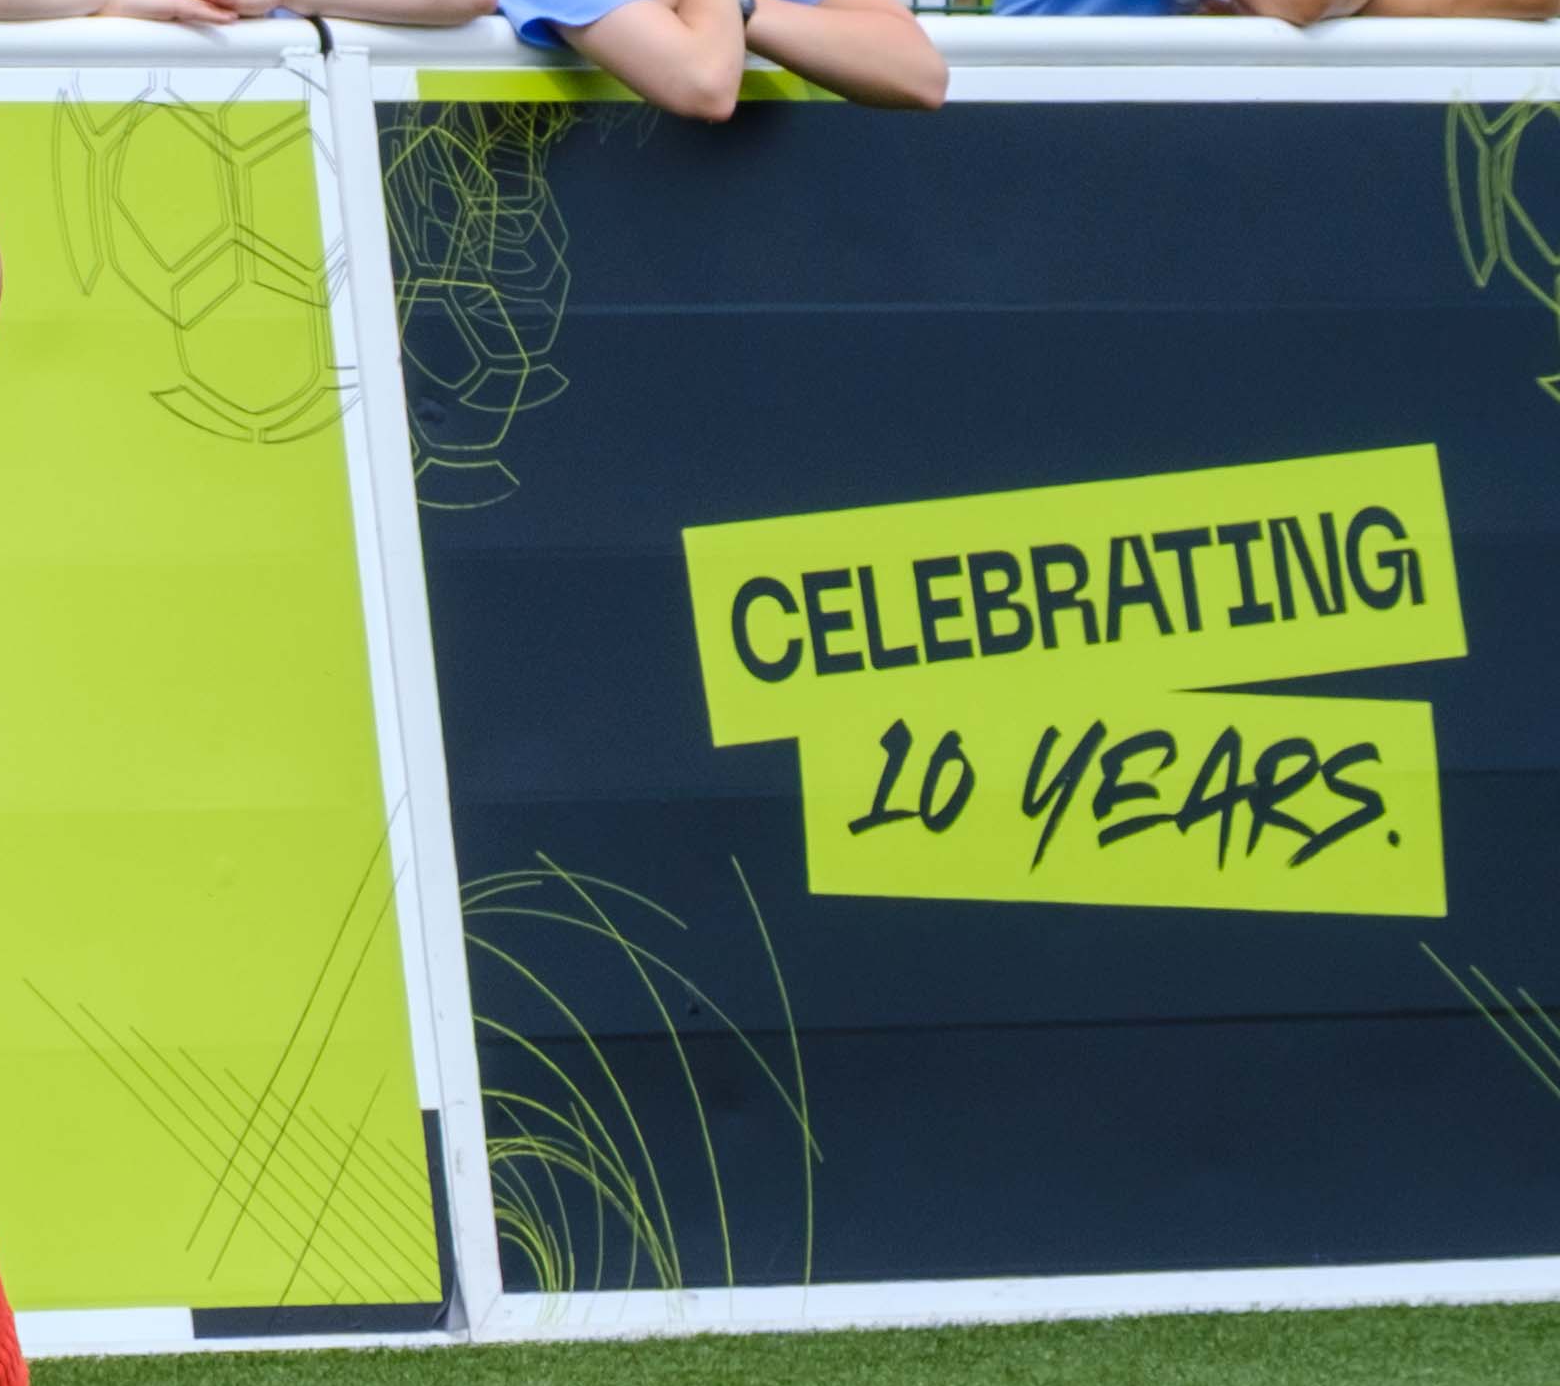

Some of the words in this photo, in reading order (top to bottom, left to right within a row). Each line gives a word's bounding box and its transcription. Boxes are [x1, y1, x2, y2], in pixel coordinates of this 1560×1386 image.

[730, 505, 1427, 684] CELEBRATING
[847, 719, 976, 835] 10
[1021, 719, 1400, 872] YEARS.
